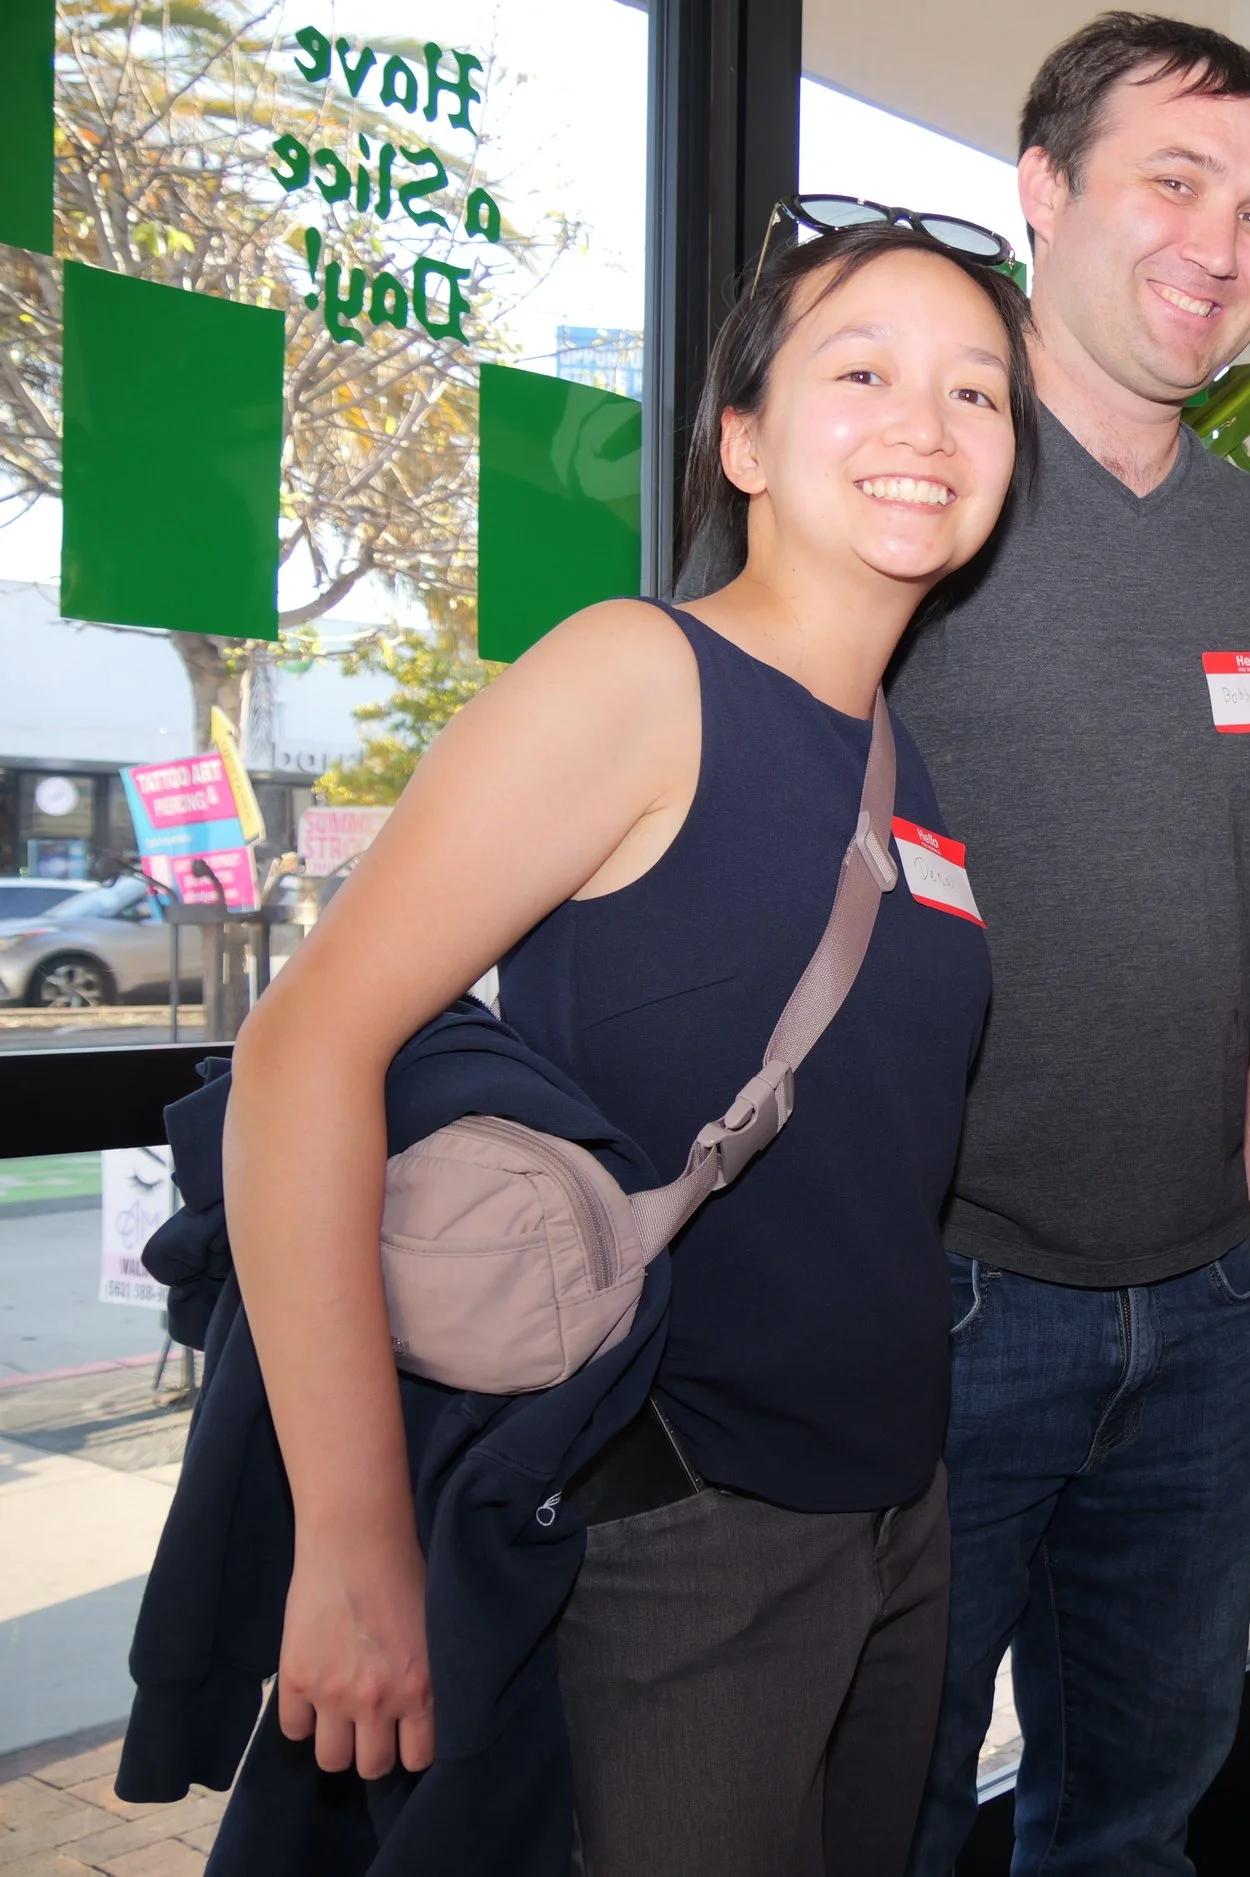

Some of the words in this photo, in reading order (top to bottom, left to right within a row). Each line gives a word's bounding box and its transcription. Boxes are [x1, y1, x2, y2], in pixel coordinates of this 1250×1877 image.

[136, 765, 191, 795] TATTOO
[191, 760, 223, 785] ART
[304, 812, 386, 835] SUMME
[917, 828, 939, 848] Hello
